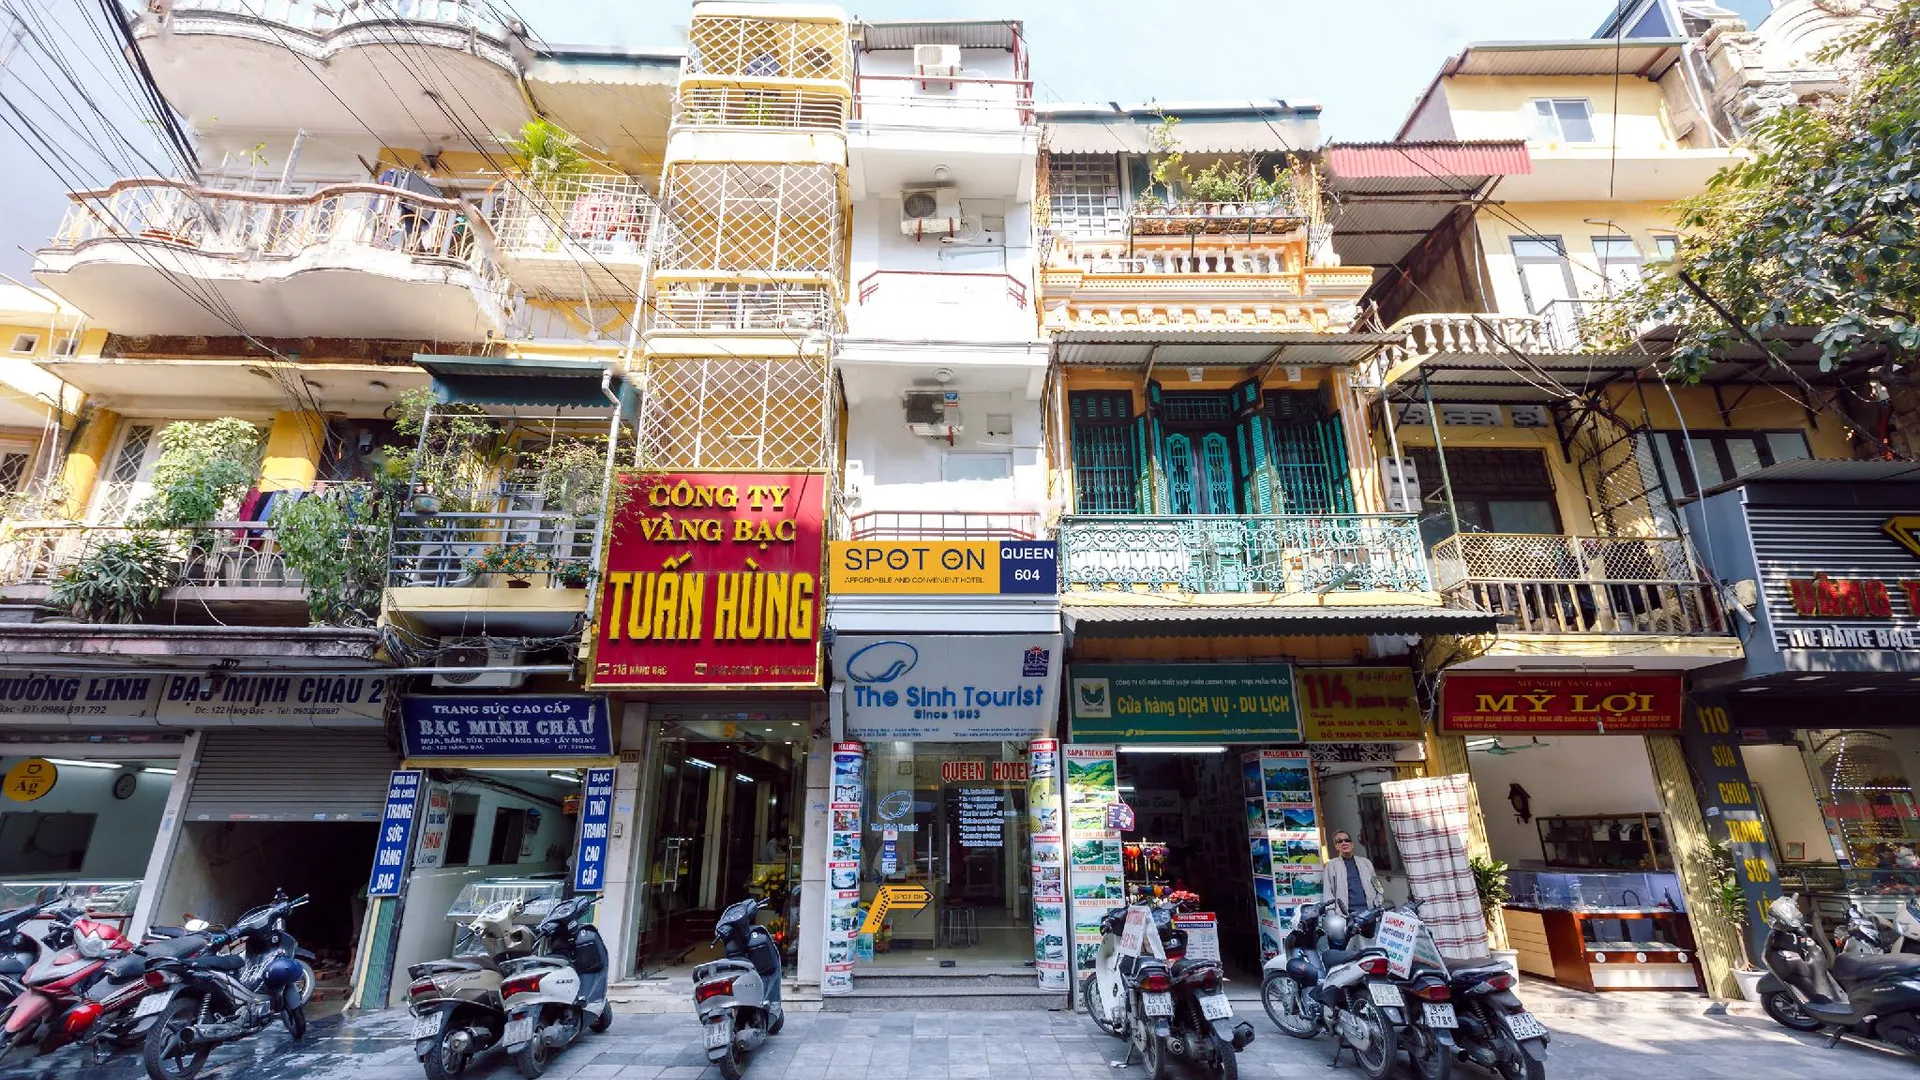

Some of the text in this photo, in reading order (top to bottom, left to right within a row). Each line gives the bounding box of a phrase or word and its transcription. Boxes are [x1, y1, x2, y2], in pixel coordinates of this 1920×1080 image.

[648, 479, 790, 511] CÔNG TY
[640, 512, 796, 550] VÀNG BẠC
[845, 548, 985, 571] SPOT ON
[1001, 547, 1055, 560] QUEEN
[1014, 568, 1041, 581] 604
[608, 551, 814, 641] TUẤN HÙNG
[1788, 571, 1892, 618] VÀNG
[1821, 624, 1871, 648] HÀNG
[1875, 628, 1914, 651] BẠC
[85, 678, 151, 701] LINH
[222, 676, 291, 703] MINH
[299, 674, 364, 704] CHÂU
[367, 679, 385, 704] 2
[853, 685, 1044, 708] The Sinh Tourist
[1303, 674, 1352, 709] 114
[226, 706, 248, 716] Hàng
[249, 707, 266, 716] Bạc
[433, 701, 571, 715] TRANG SỨC CAO CẤP
[1116, 695, 1290, 719] Cửa hàng DỊCH VỤ DU LỊCH
[1475, 689, 1655, 717] MỸ LỢI
[913, 709, 981, 720] Since 1993
[1697, 706, 1730, 734] 110
[418, 716, 595, 738] BẠC MINH CHÂU
[466, 736, 483, 744] SỬA
[485, 736, 508, 744] CHỮA
[509, 736, 533, 744] VÀNG
[534, 737, 551, 745] BẠC
[554, 735, 570, 744] LẤY
[1067, 749, 1114, 757] SAPA TREKKING
[1711, 740, 1737, 767] SỬA
[592, 773, 610, 784] BẠC
[942, 761, 986, 783] QUEEN
[389, 786, 401, 799] SỬA
[1718, 779, 1751, 804] CHỮA
[386, 803, 413, 819] TRANG
[386, 823, 404, 842] SỨC
[583, 823, 607, 839] TRANG
[1725, 820, 1767, 843] TRANG
[379, 846, 402, 866] VÀNG
[584, 845, 600, 862] CAO
[582, 864, 598, 886] CẤP
[1744, 855, 1771, 883] SỨC
[377, 873, 395, 893] BẠC
